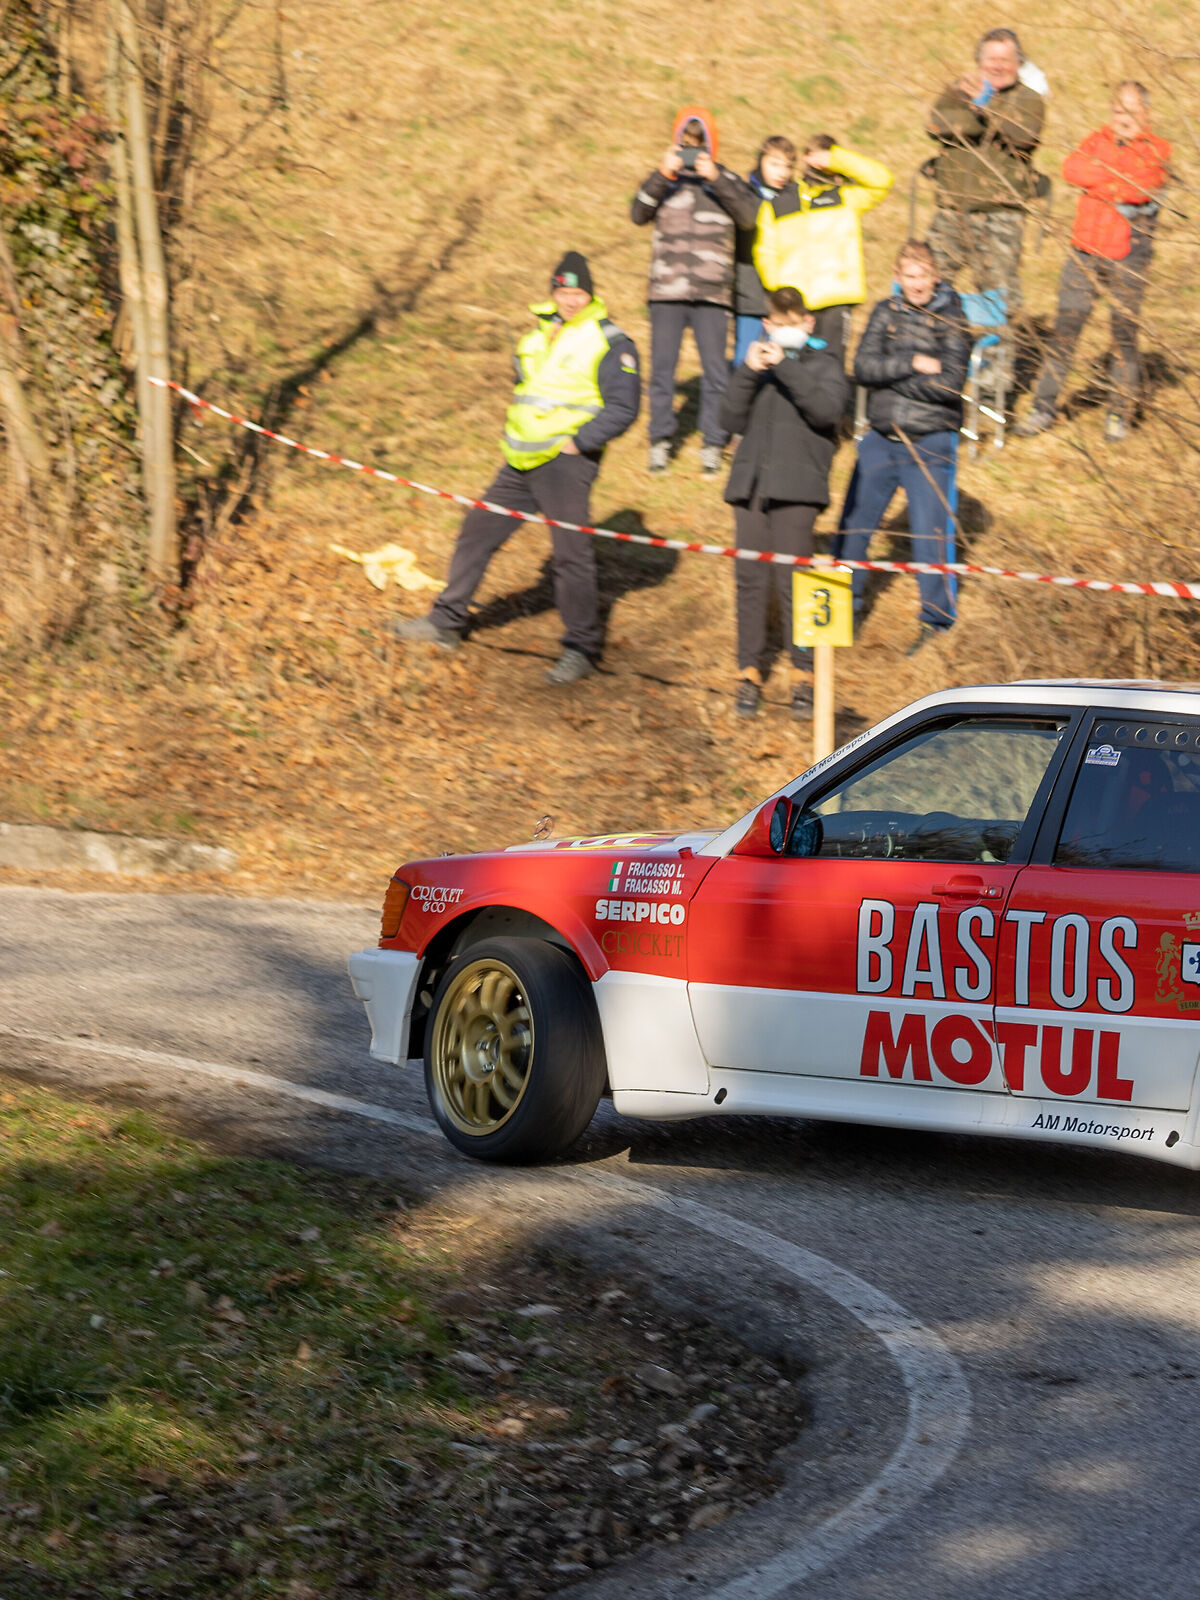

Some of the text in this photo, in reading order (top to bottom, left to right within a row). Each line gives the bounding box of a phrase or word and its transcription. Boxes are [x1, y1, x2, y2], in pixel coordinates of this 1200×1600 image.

[813, 588, 831, 627] 3
[801, 730, 871, 781] AM Motorsport
[627, 862, 685, 878] FRACASSO L.
[410, 885, 464, 903] CRICKET
[624, 878, 682, 895] FRACASSO M.
[595, 899, 685, 925] SERPICO
[601, 930, 684, 957] CRICKET
[856, 897, 1139, 1012] BASTOS
[860, 1010, 1134, 1101] MOTUL
[1031, 1113, 1156, 1142] AM Motorsport
